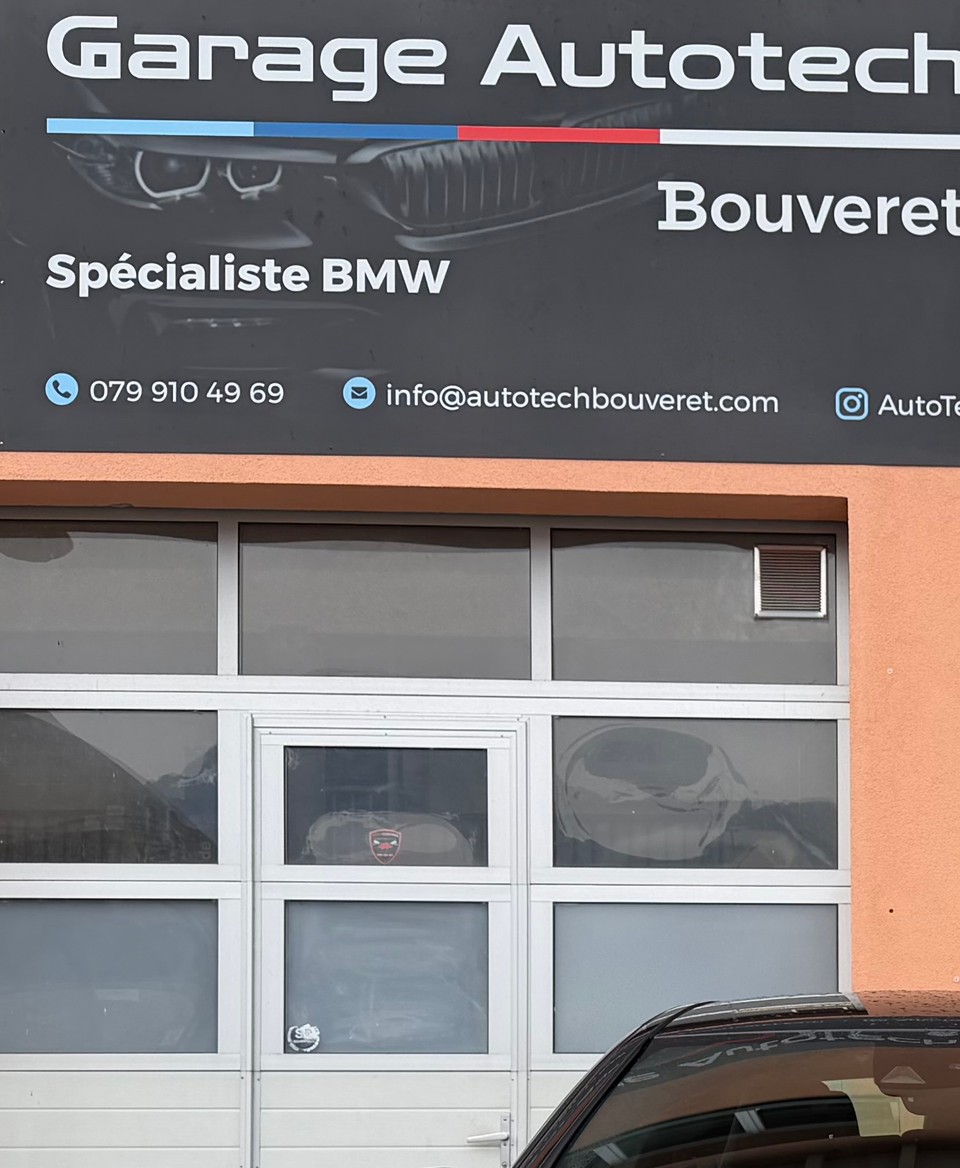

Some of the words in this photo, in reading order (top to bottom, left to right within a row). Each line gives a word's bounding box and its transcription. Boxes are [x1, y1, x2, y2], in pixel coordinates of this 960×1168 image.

[46, 15, 448, 102] Garage
[45, 251, 310, 298] Spécialiste
[322, 258, 451, 294] BMW
[88, 379, 144, 403] 079
[150, 380, 201, 404] 910
[205, 381, 242, 405] 49
[248, 381, 285, 405] 69
[386, 383, 780, 414] info@autotechbouveret.com
